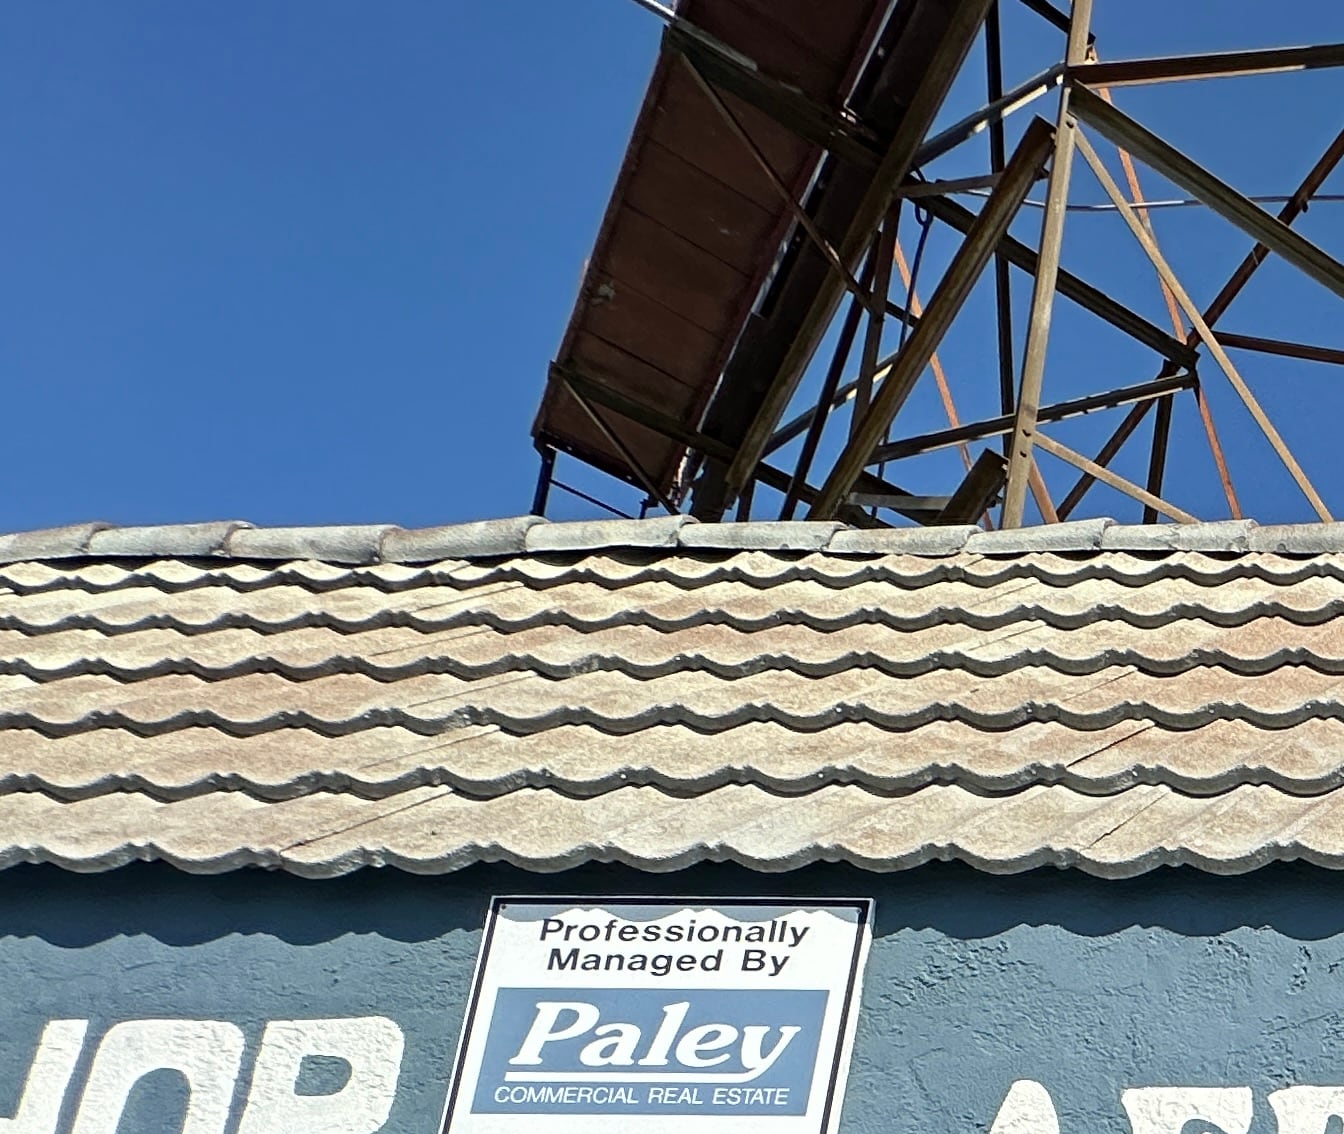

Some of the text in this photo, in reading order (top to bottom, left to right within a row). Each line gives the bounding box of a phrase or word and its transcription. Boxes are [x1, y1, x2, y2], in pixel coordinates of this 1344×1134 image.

[540, 918, 809, 948] Professionally
[546, 947, 790, 976] Managed By
[508, 1001, 801, 1083] Paley
[494, 1086, 790, 1105] COMMERCIAL REAL ESTATE
